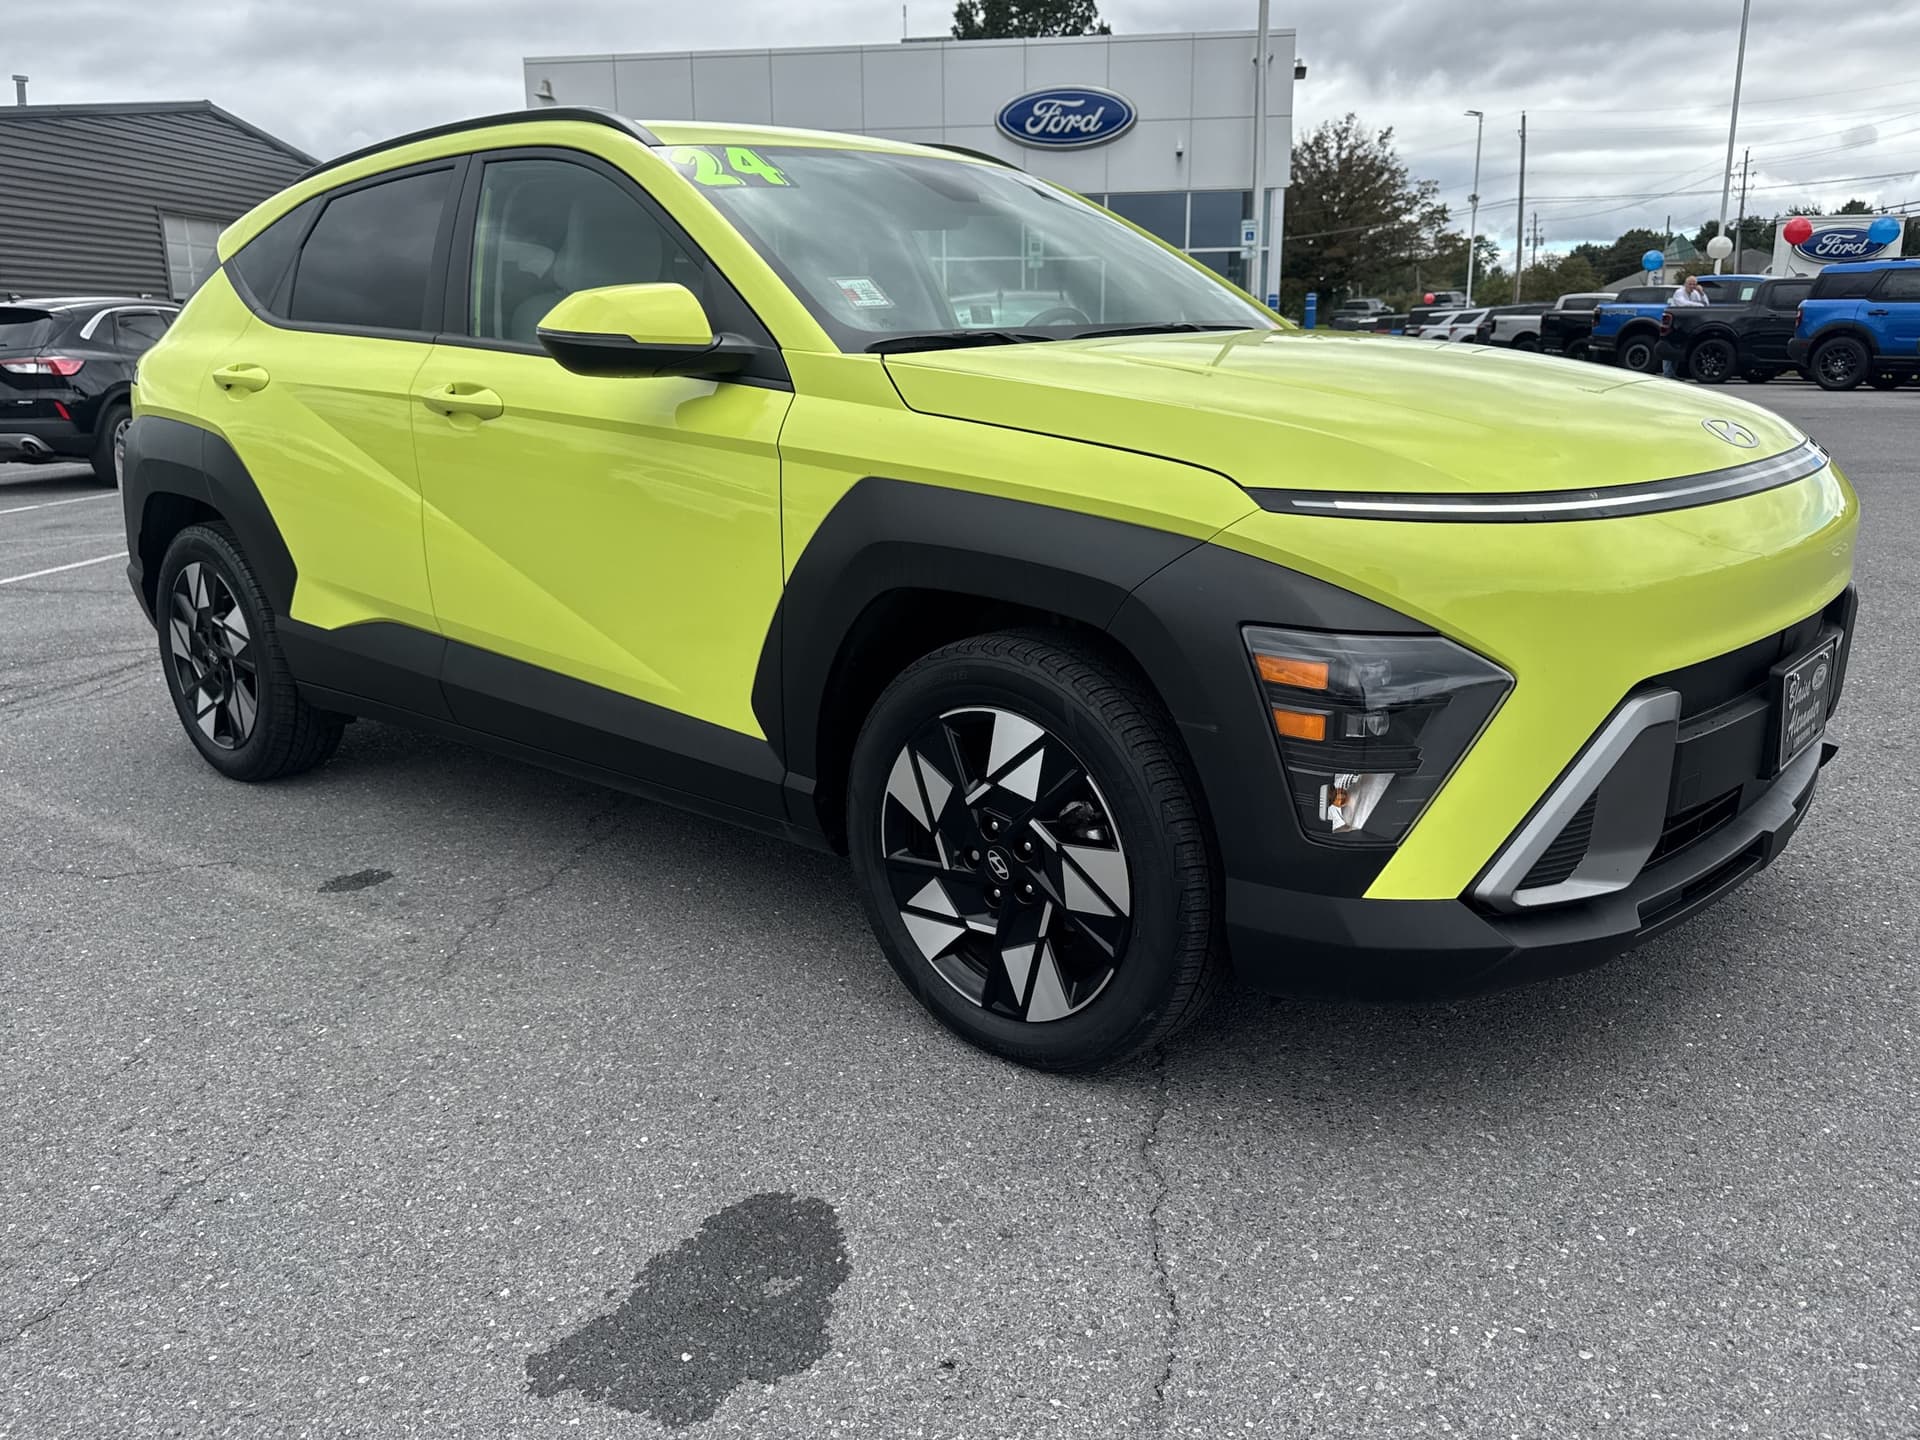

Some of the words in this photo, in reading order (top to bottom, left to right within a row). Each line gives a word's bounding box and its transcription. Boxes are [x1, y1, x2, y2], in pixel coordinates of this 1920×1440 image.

[1025, 99, 1105, 135] Ford
[671, 146, 790, 186] 24
[1815, 233, 1870, 255] Ford
